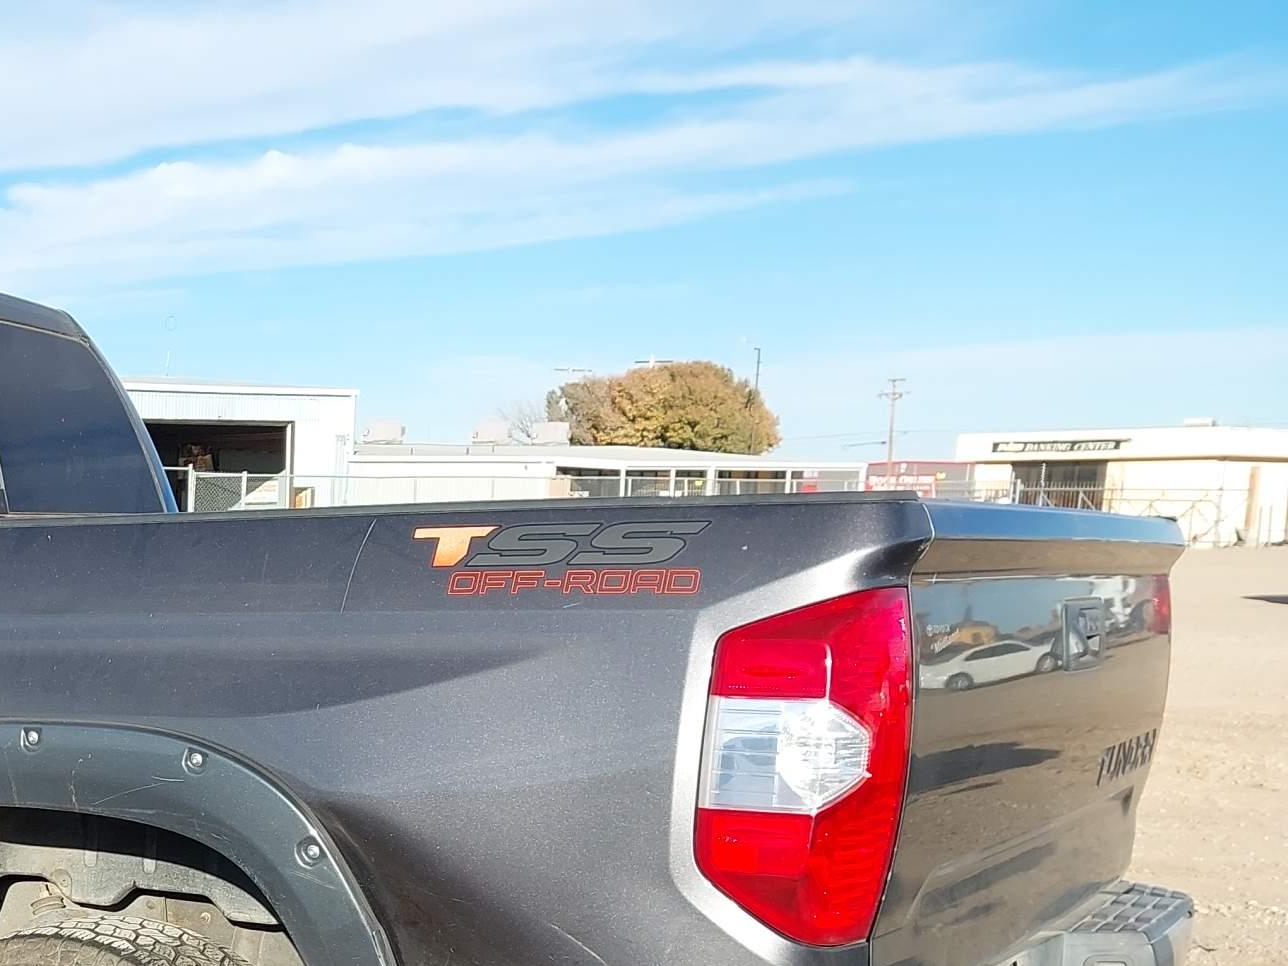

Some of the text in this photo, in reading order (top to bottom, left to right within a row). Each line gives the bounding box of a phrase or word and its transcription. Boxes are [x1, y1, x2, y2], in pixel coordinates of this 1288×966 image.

[1073, 440, 1117, 451] CENTER
[412, 520, 712, 568] TSS
[447, 568, 702, 596] OFF-ROAD
